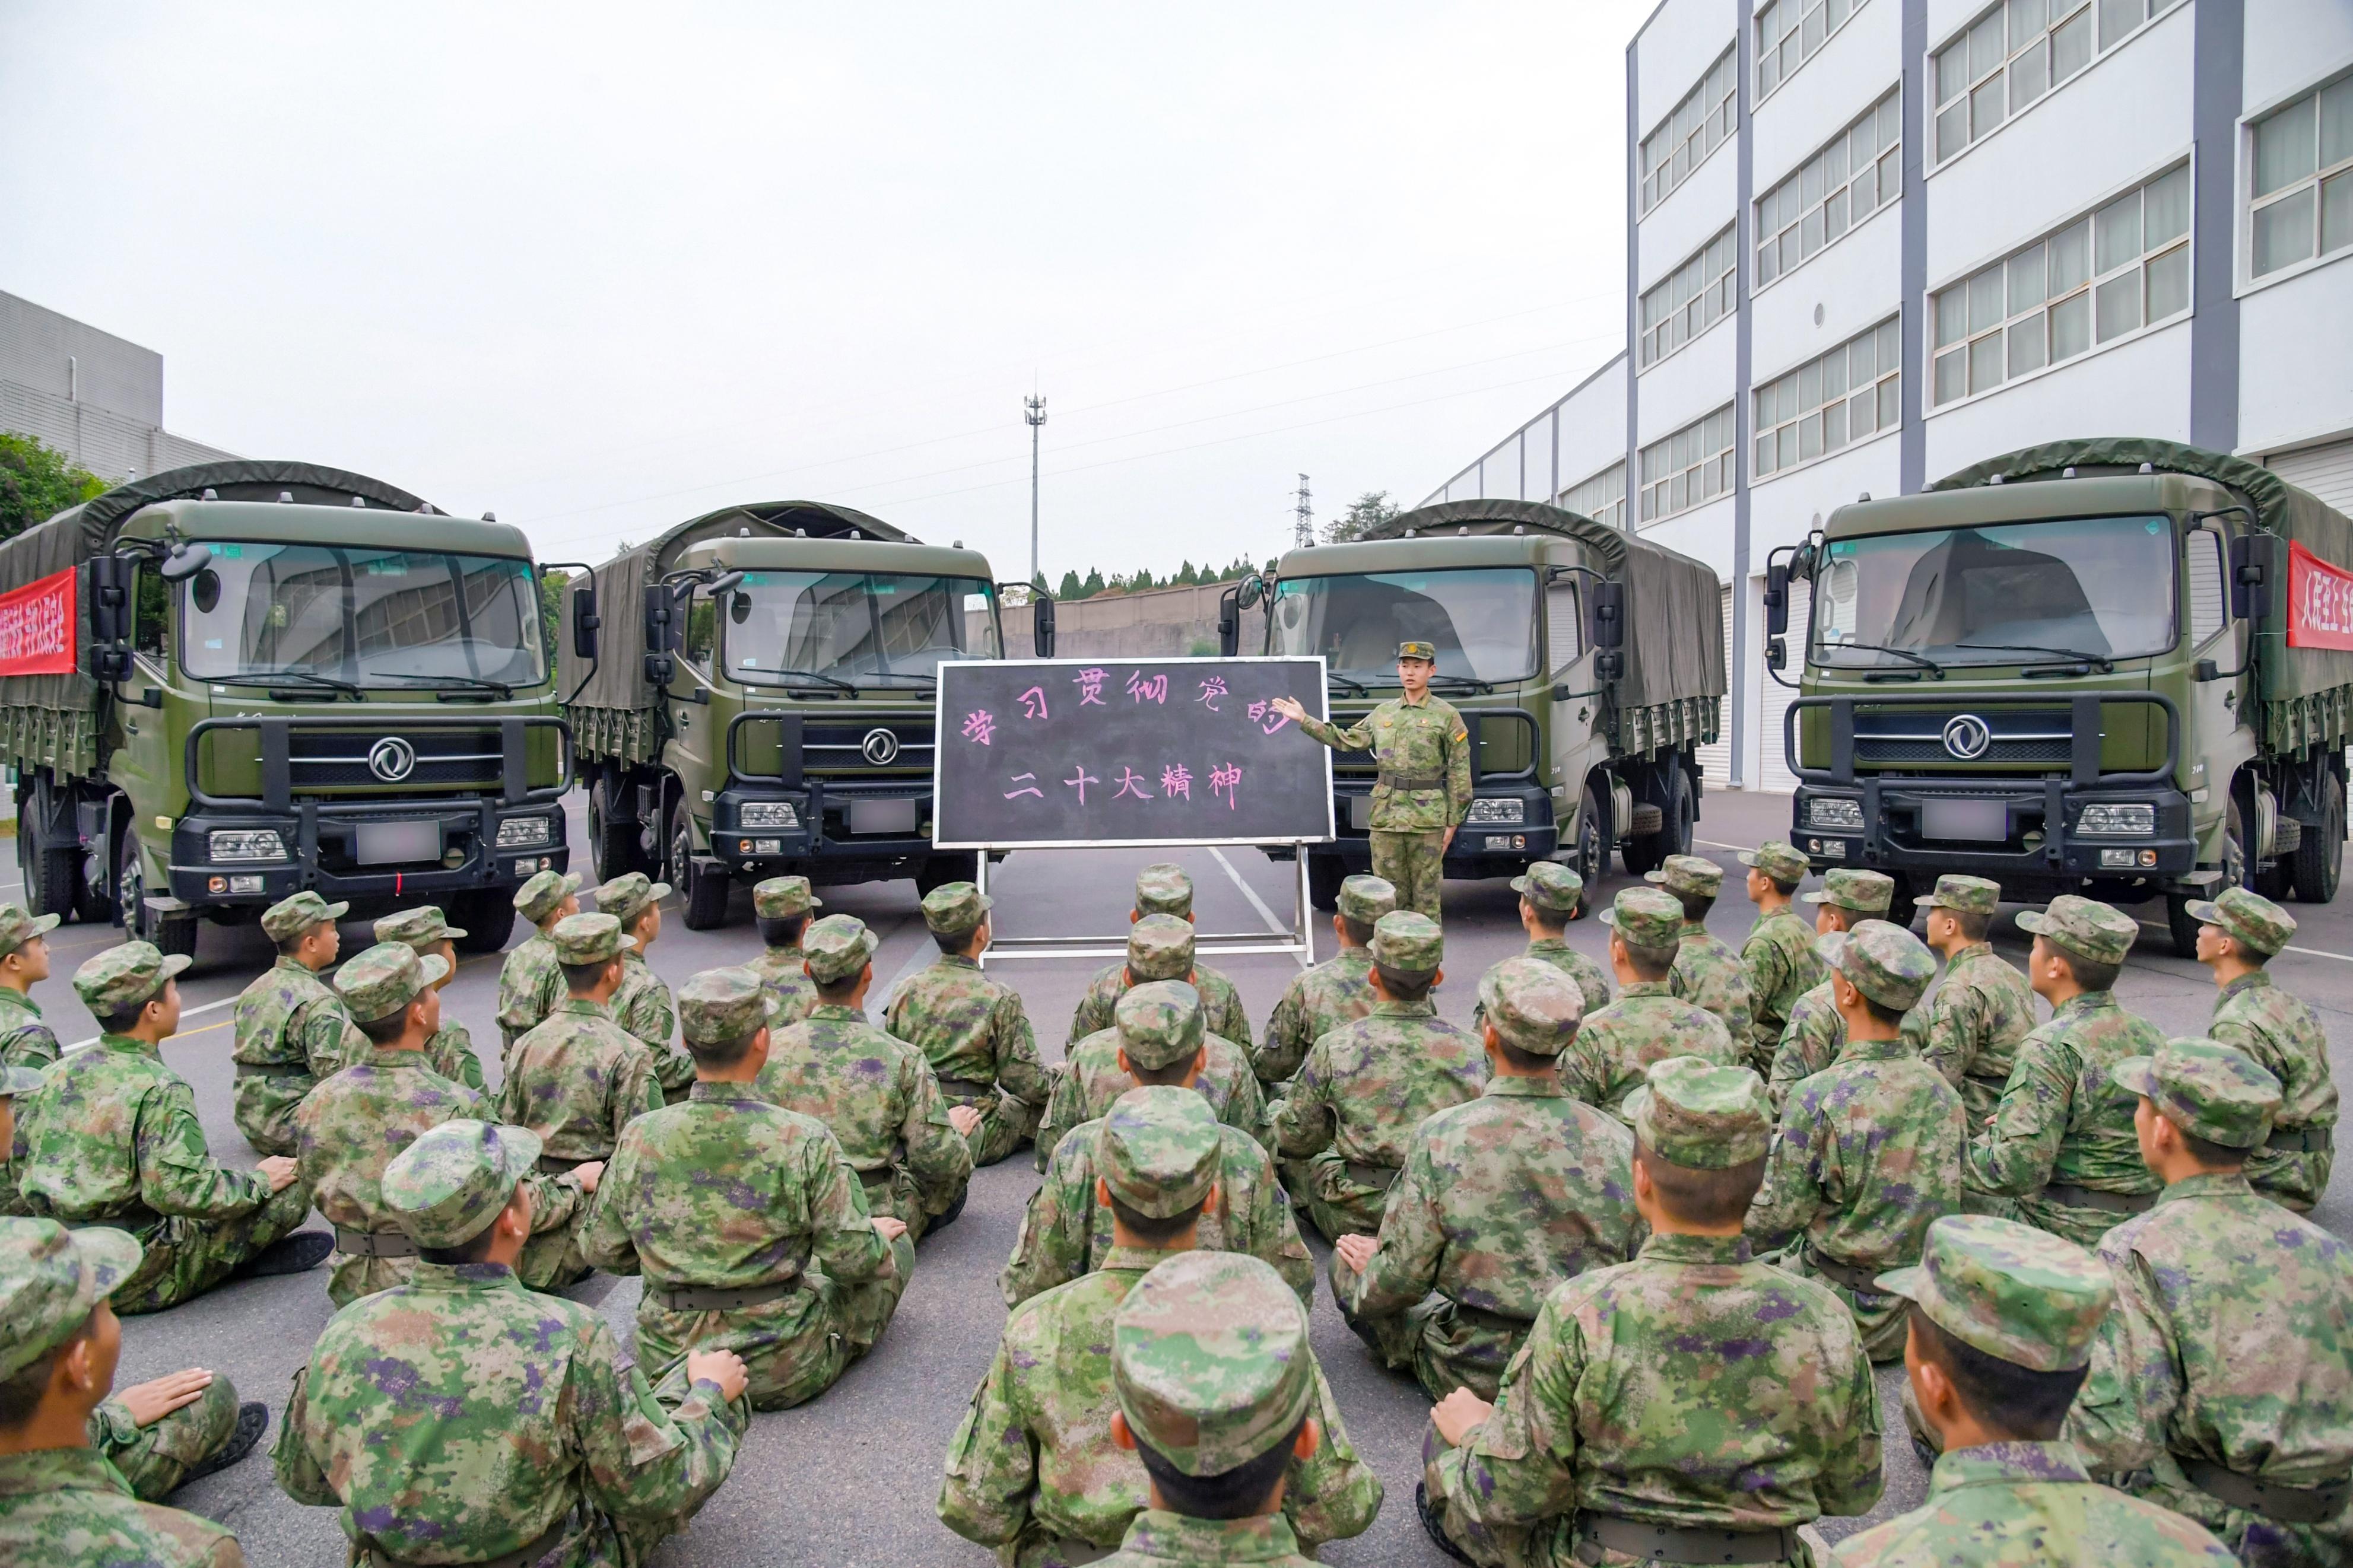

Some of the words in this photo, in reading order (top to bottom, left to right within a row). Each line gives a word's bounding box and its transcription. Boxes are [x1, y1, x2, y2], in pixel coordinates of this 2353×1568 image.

[961, 668, 1291, 746] 学习贯彻党的
[1003, 762, 1242, 810] 二十大精神
